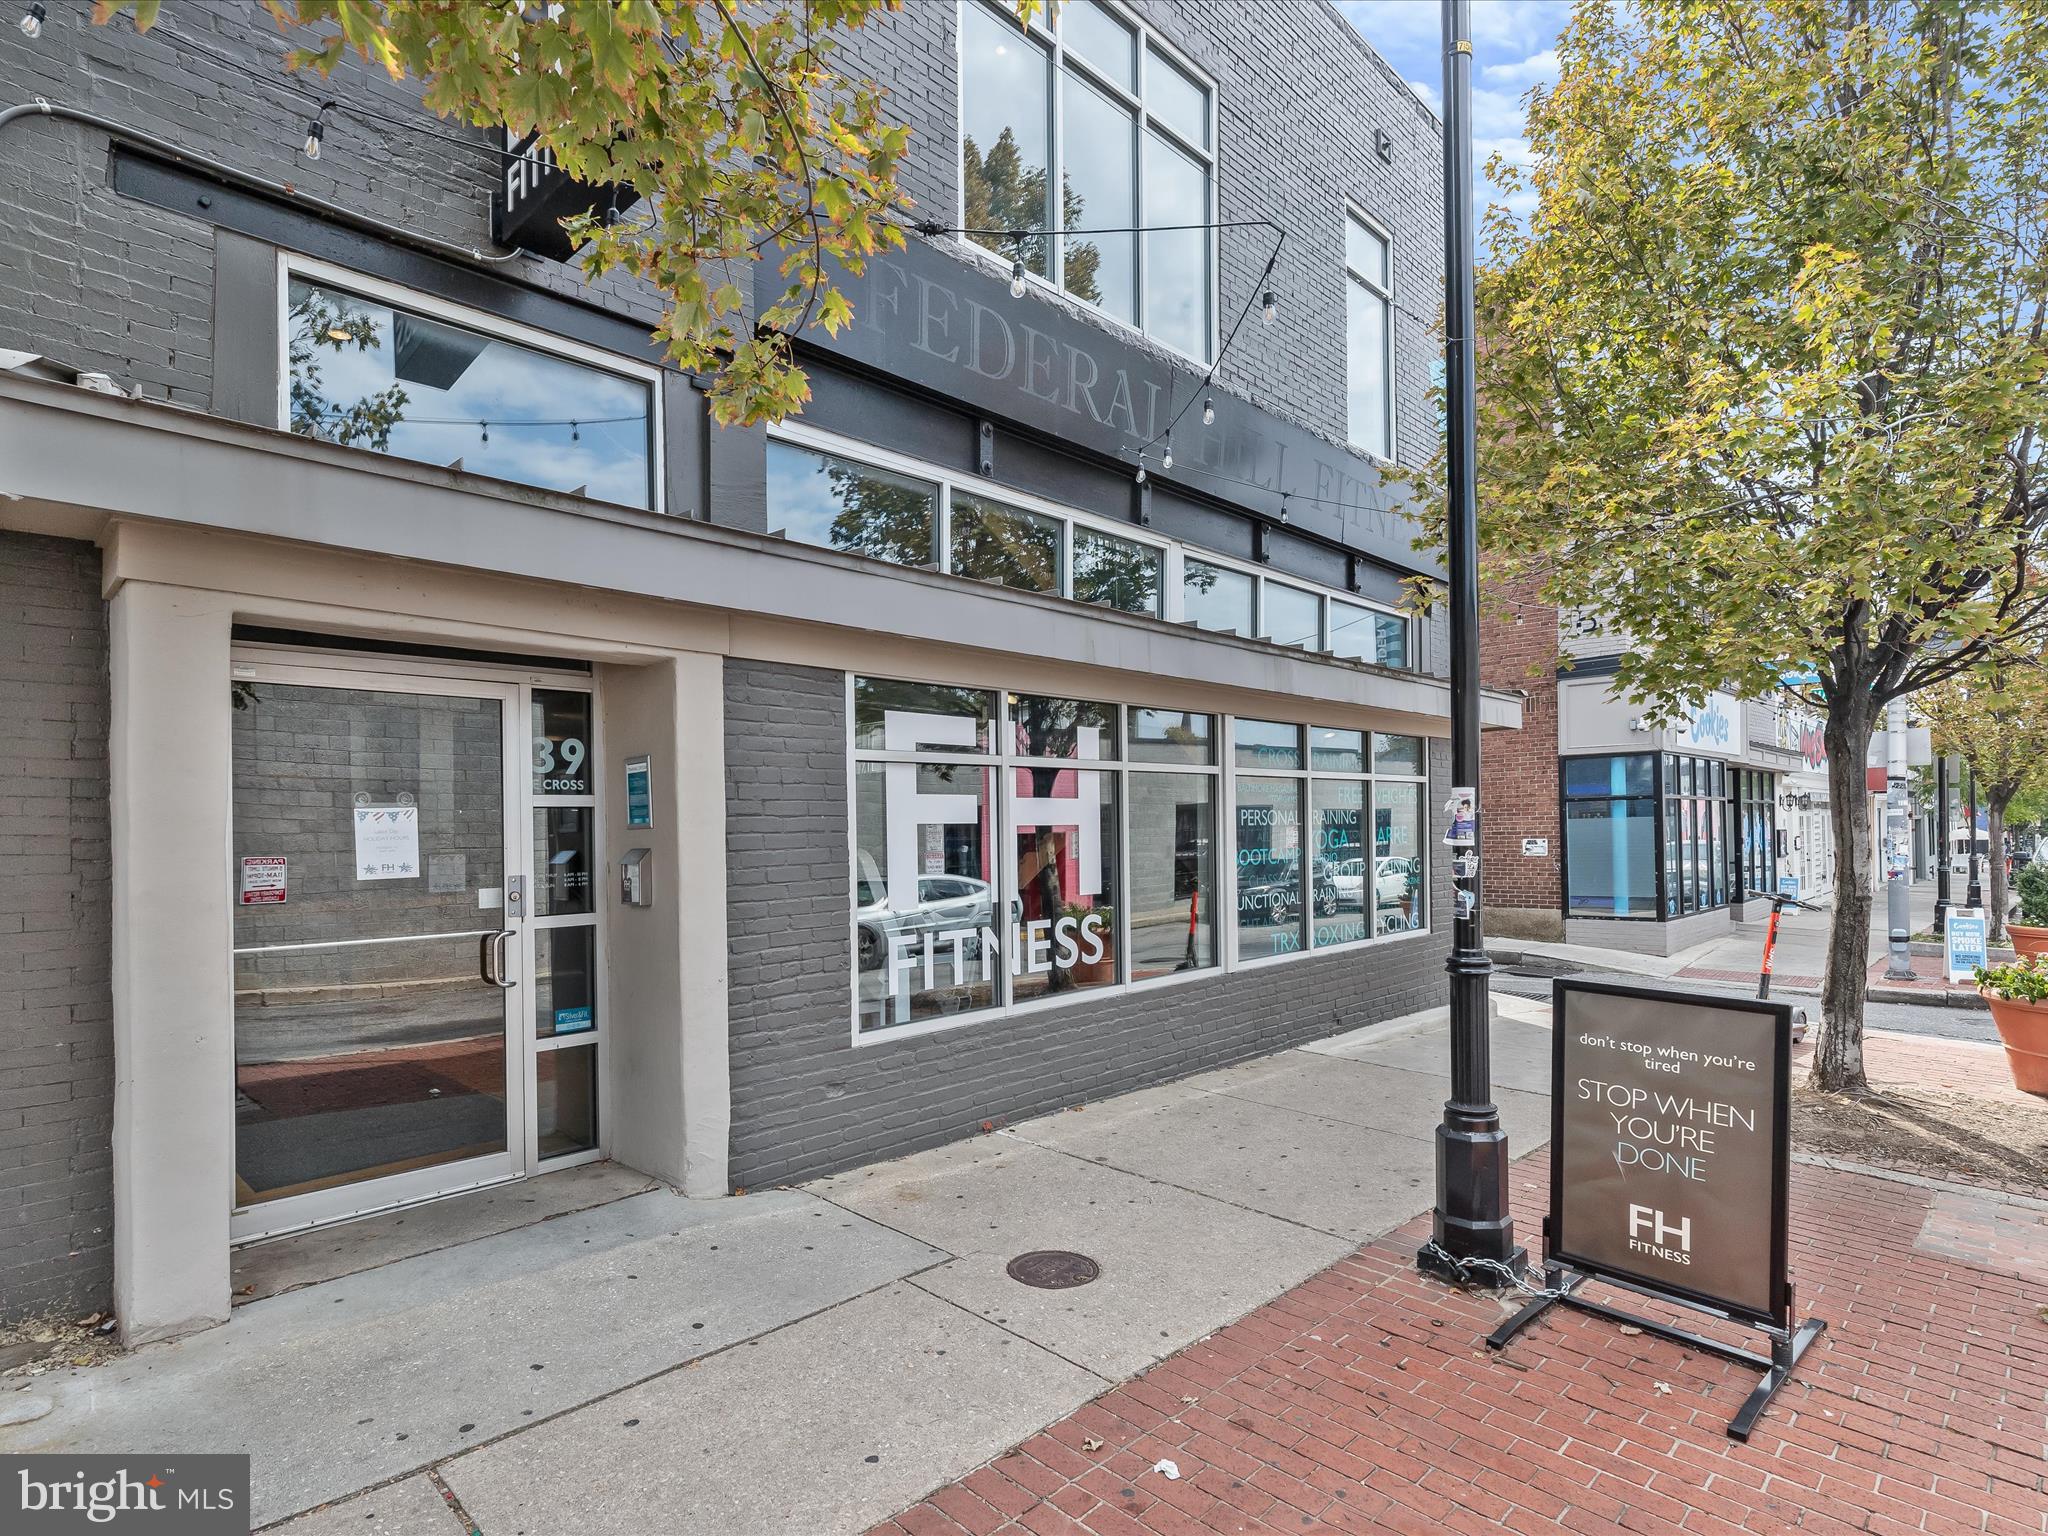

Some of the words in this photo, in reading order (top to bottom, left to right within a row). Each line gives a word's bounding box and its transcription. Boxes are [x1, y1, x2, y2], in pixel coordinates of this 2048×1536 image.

[863, 257, 1168, 446] FEDERAL
[1690, 698, 1729, 746] Cookies
[1312, 751, 1362, 770] RAINING
[543, 779, 584, 790] CROSS
[885, 710, 1102, 910] FH
[1240, 808, 1302, 826] PERSONAL
[1312, 808, 1357, 825] RAINING
[1377, 825, 1408, 844] ARRE
[1234, 847, 1303, 867] OOTCAMP
[1323, 861, 1366, 881] GROUP
[1237, 891, 1303, 911] UNCTIONAL
[1271, 930, 1300, 953] TRX
[1951, 937, 1983, 945] SMOKE
[1952, 944, 1983, 953] LATER
[888, 914, 1104, 996] FITNESS
[1580, 1033, 1616, 1049] don't
[1620, 1041, 1652, 1057] stop
[1657, 1046, 1698, 1062] when
[1703, 1054, 1756, 1071] you're
[1645, 1058, 1680, 1074] tired
[1578, 1078, 1647, 1109] STOP
[1654, 1092, 1754, 1132] WHEN
[1610, 1112, 1715, 1154] YOU'RE
[1618, 1142, 1706, 1182] DONE
[1630, 1203, 1691, 1252] FH
[1629, 1239, 1691, 1265] FITNESS
